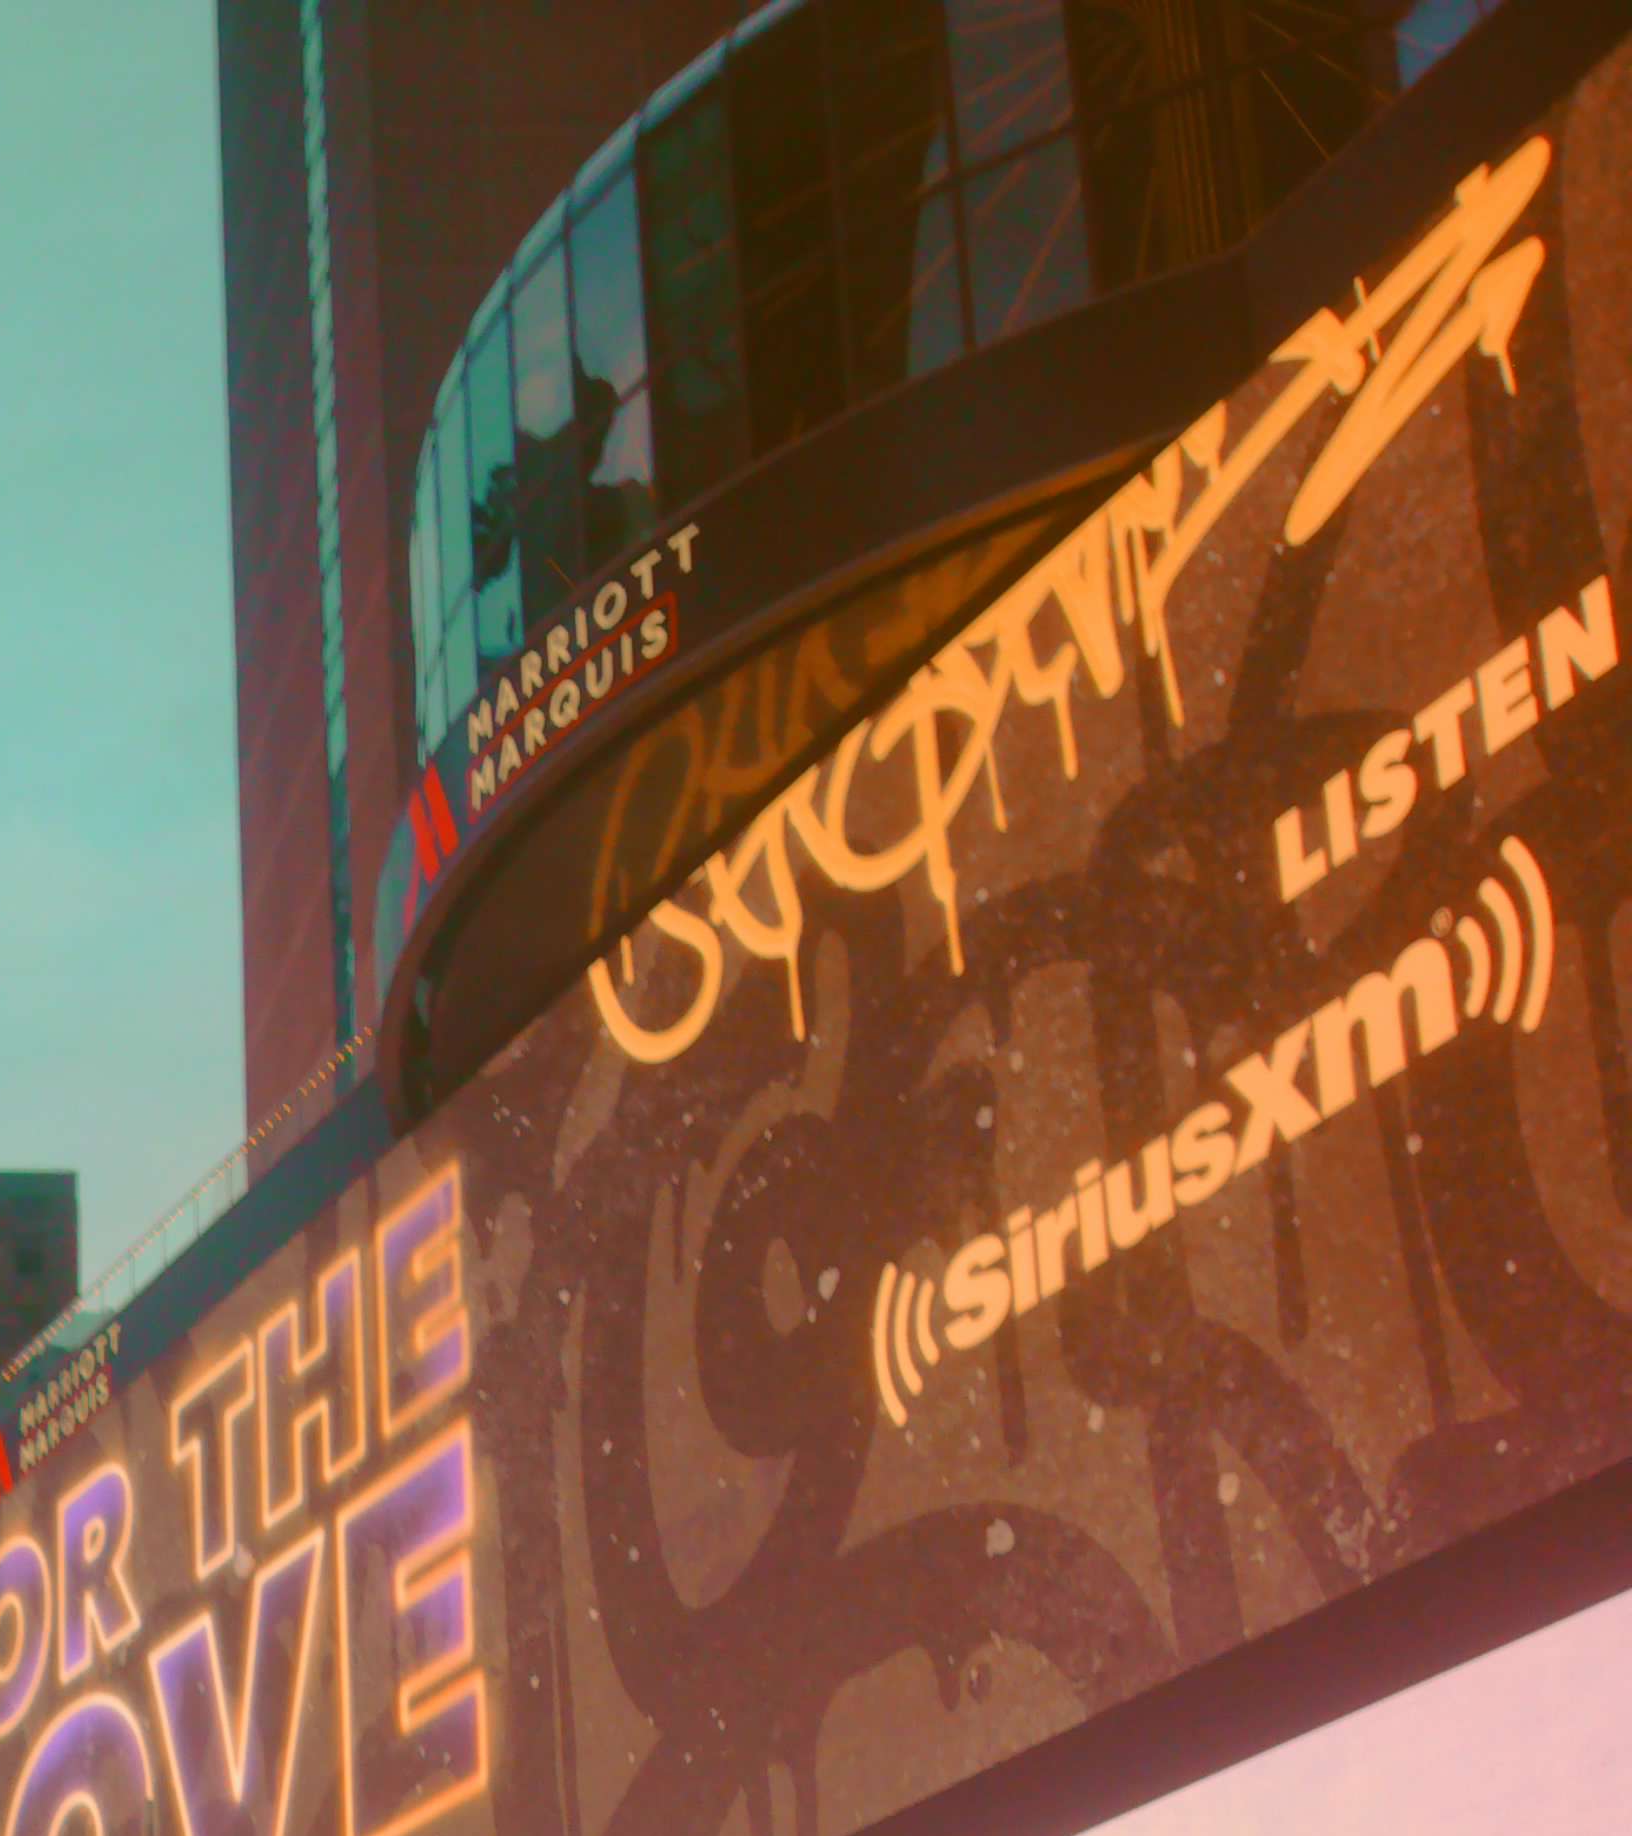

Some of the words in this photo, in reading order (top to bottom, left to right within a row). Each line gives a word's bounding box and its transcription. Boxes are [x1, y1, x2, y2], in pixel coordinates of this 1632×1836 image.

[468, 522, 699, 755] MARRIOTT
[470, 608, 669, 812] MARQUIS
[1272, 575, 1621, 903] LISTEN
[19, 1321, 121, 1439] MARRIOTT
[19, 1372, 110, 1473] MARQUIS
[170, 1158, 474, 1579] THE
